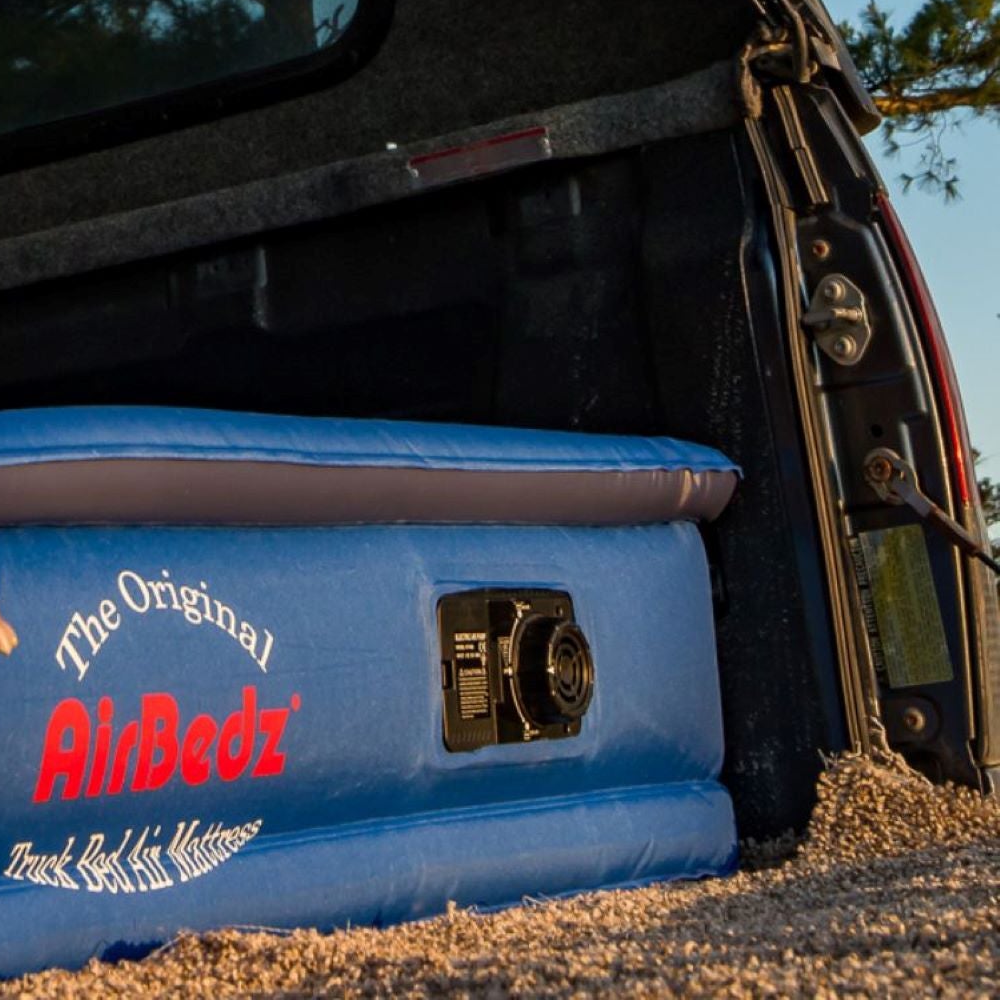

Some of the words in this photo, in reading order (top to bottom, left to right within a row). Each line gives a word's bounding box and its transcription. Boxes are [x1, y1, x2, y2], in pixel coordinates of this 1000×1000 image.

[56, 599, 121, 681] The
[117, 568, 274, 673] Original
[31, 685, 290, 804] AirBedz
[3, 837, 79, 890] Truck
[76, 829, 133, 894] Bed
[127, 825, 173, 890] Air
[167, 819, 262, 882] Mattress
